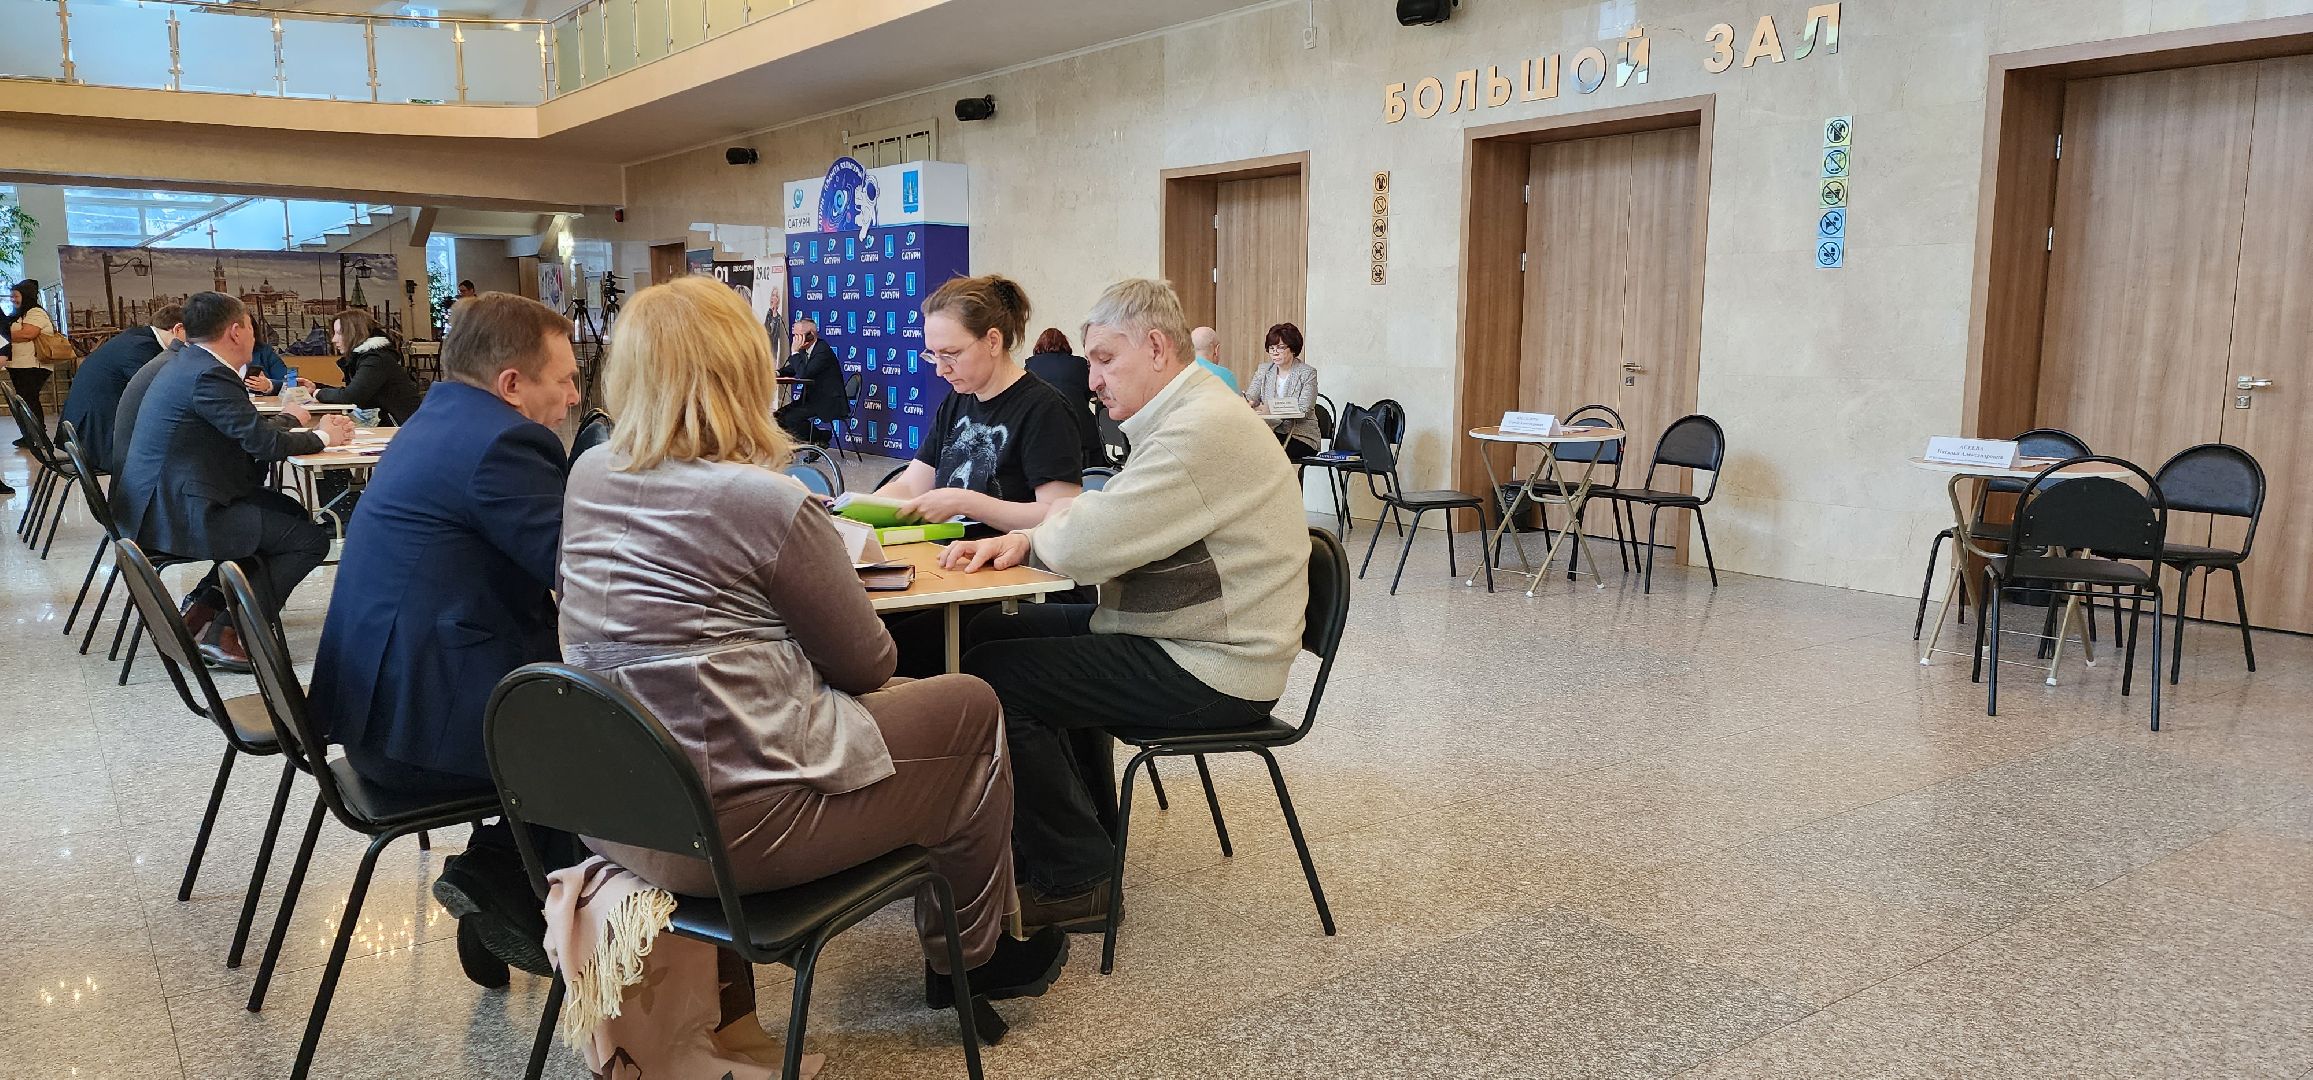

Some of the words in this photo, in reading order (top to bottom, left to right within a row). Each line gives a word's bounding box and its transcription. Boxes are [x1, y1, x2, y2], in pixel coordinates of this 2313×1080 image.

[1384, 27, 1651, 124] БОЛЬШОЙ
[1703, 2, 1842, 75] ЗАЛ
[901, 252, 920, 260] САТУРН
[880, 291, 900, 300] САТУРН
